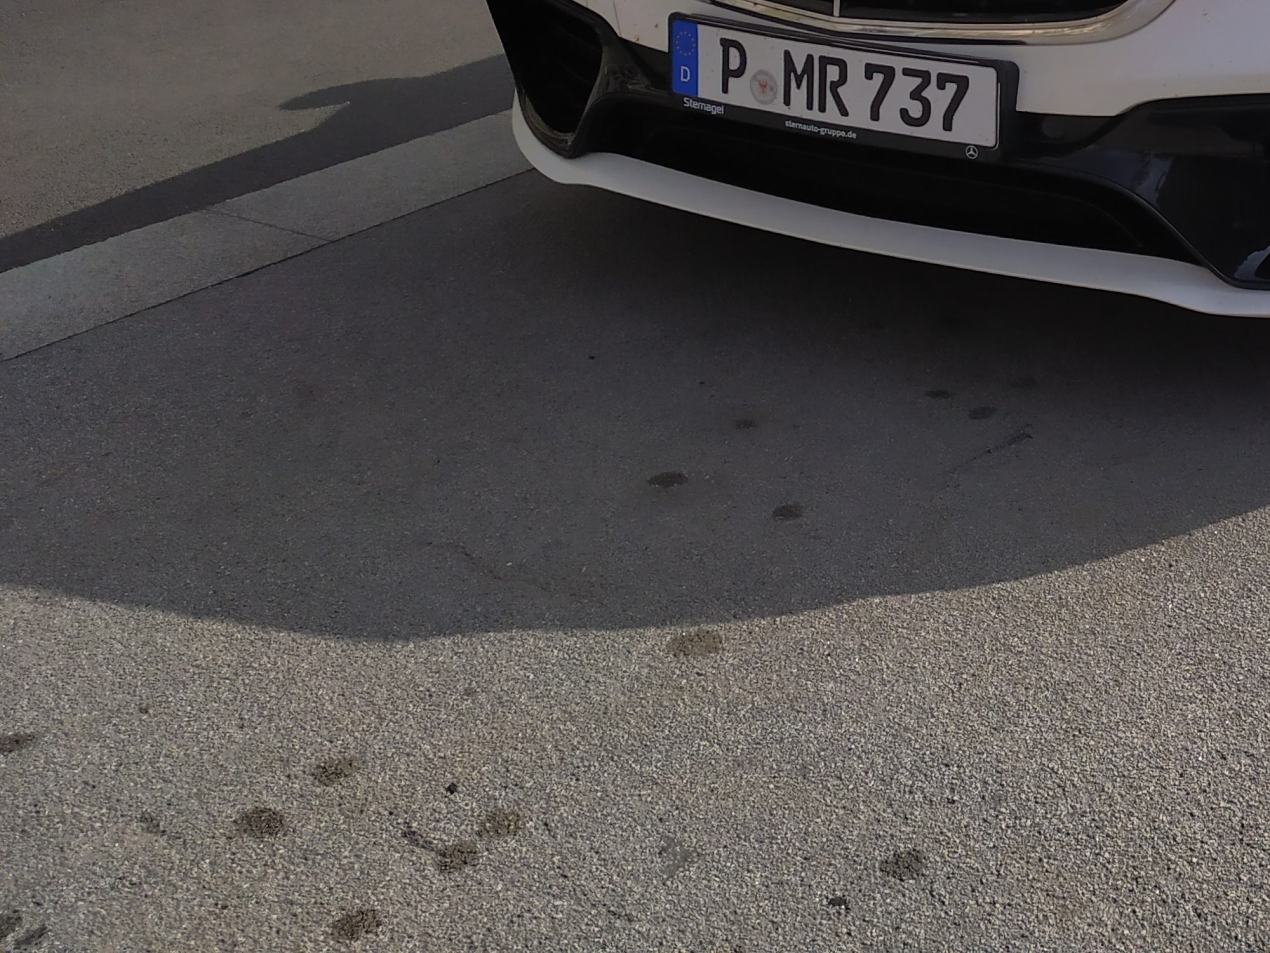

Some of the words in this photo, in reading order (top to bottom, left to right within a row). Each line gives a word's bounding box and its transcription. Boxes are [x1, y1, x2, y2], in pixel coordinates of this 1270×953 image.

[680, 66, 691, 82] D
[719, 37, 747, 95] P
[783, 49, 850, 118] MR
[864, 62, 970, 132] 737
[683, 97, 725, 115] Sternagel
[785, 119, 857, 140] sternauto-gruppe.de
